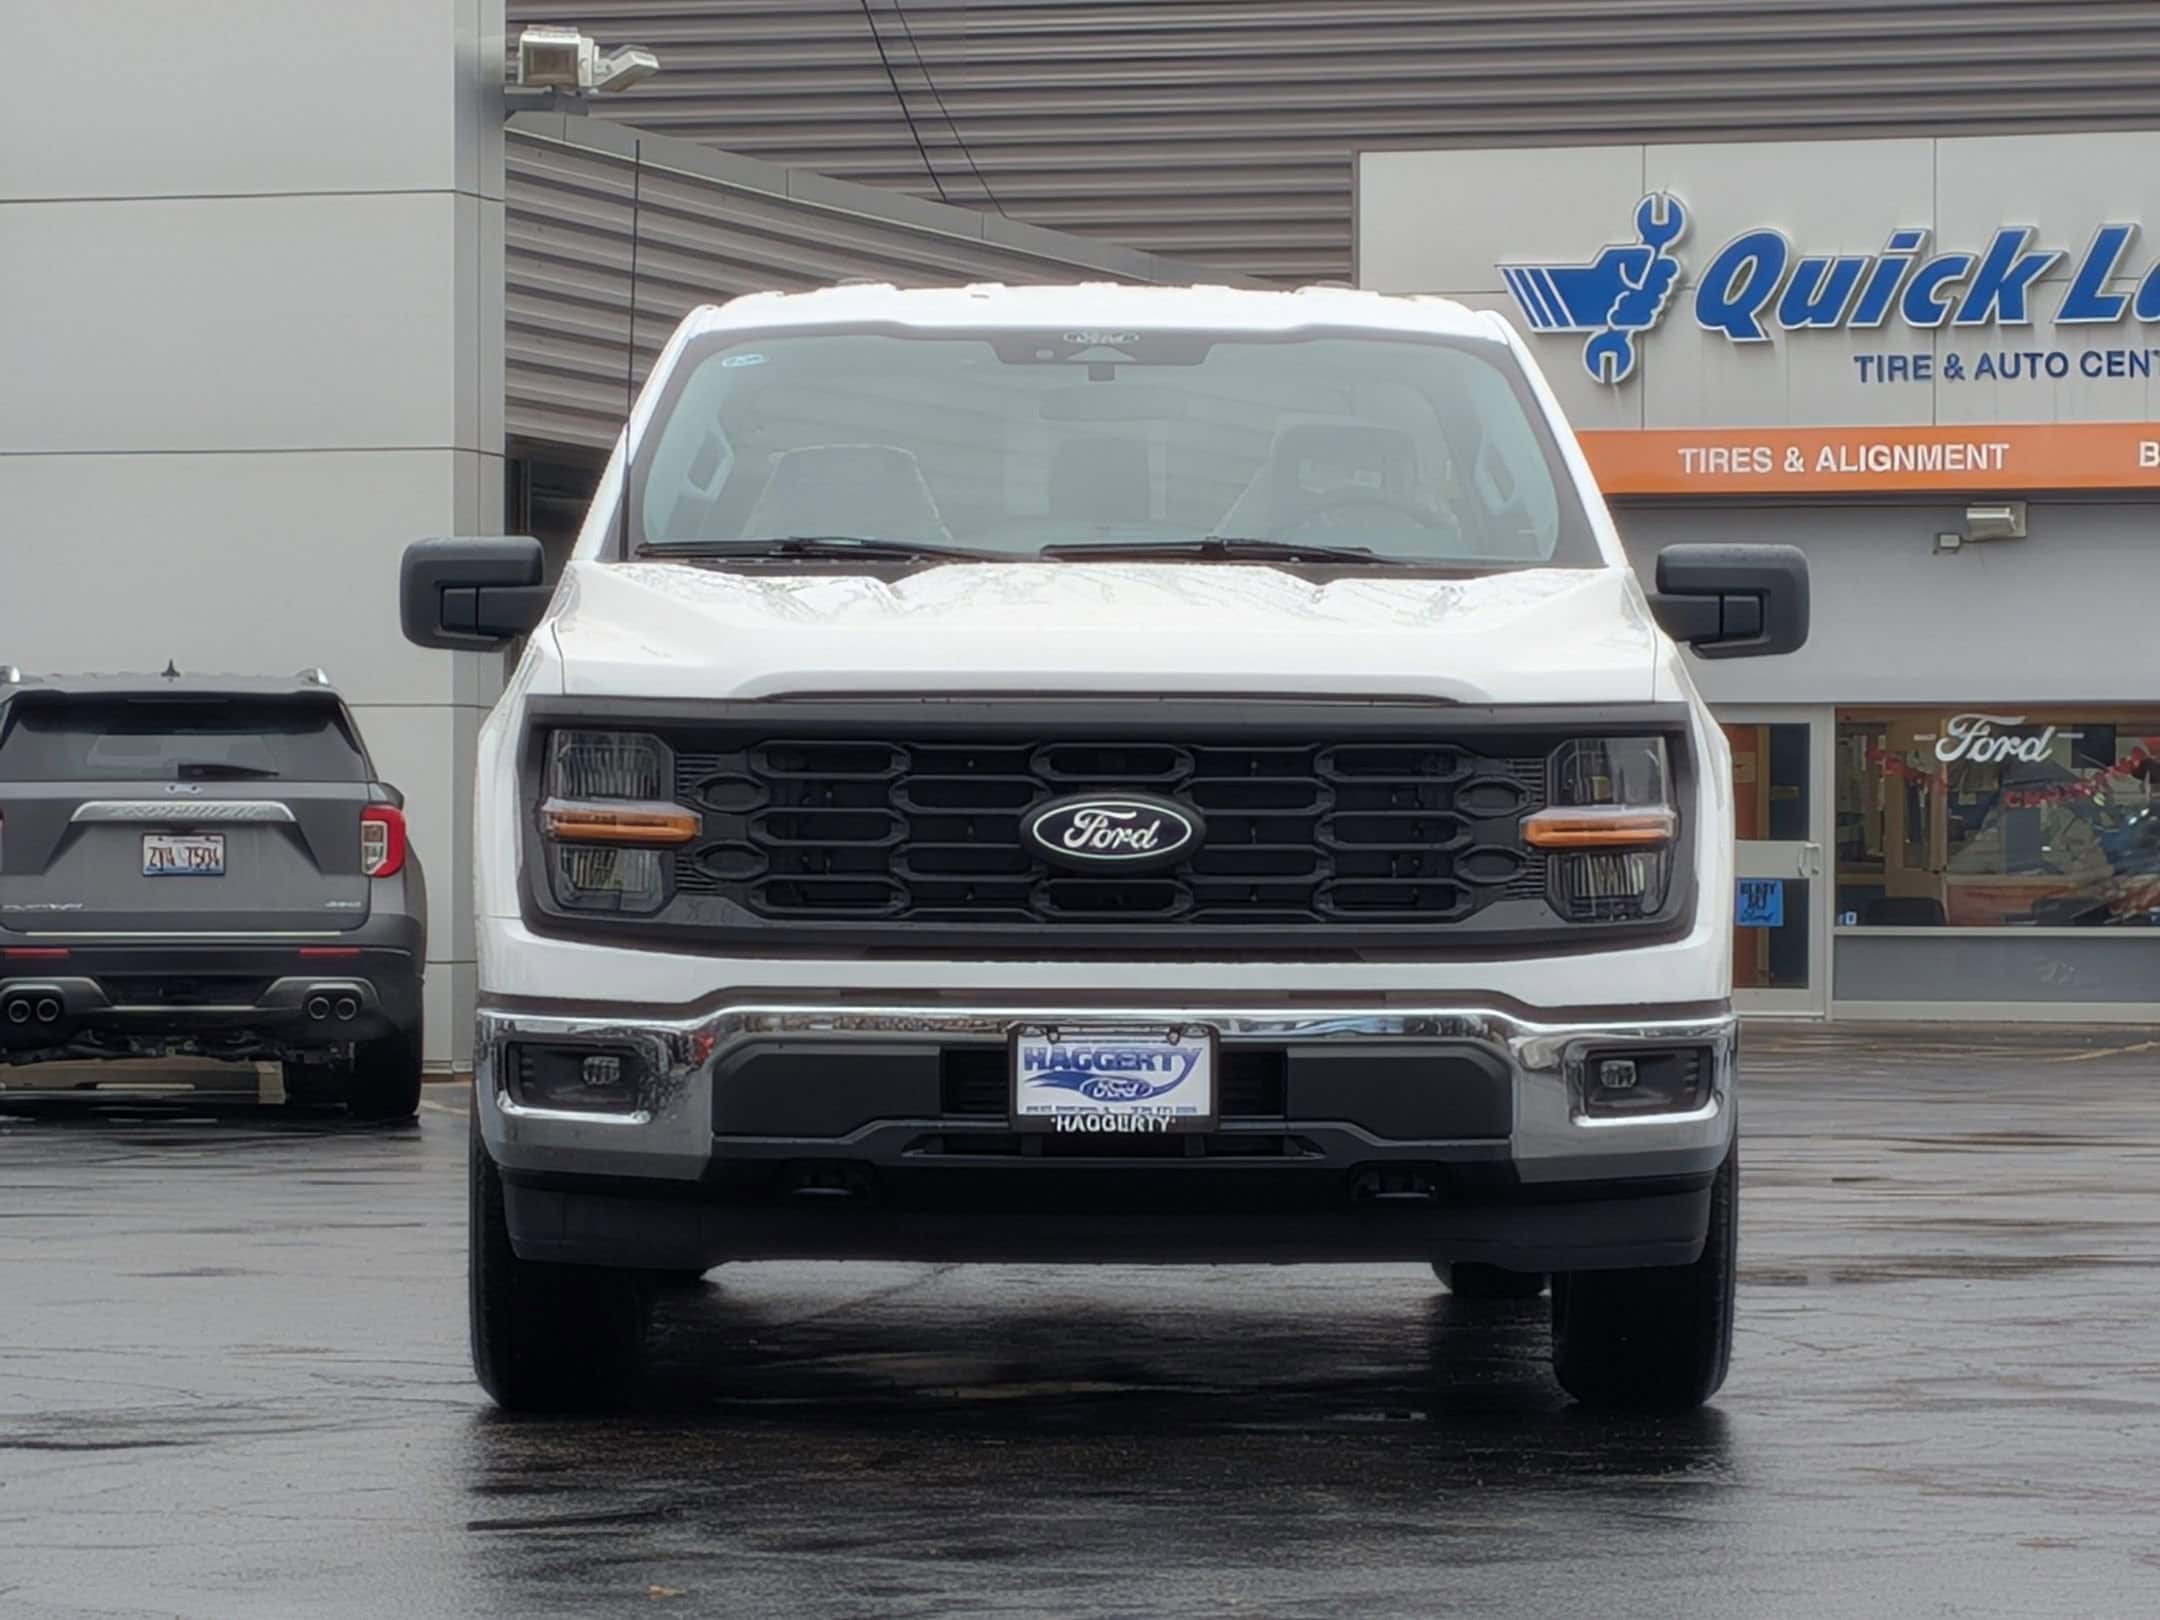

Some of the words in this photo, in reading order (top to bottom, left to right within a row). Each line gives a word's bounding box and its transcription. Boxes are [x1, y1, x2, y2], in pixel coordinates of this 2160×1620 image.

[1695, 227, 2066, 342] Quick
[1853, 354, 1932, 383] TIRE
[1943, 352, 1965, 381] &
[1974, 350, 2069, 381] AUTO
[1678, 446, 1773, 473] TIRES
[1783, 446, 1805, 473] &
[1815, 443, 2010, 473] ALIGNMENT
[1935, 713, 2056, 762] Ford
[1063, 808, 1161, 849] Ford
